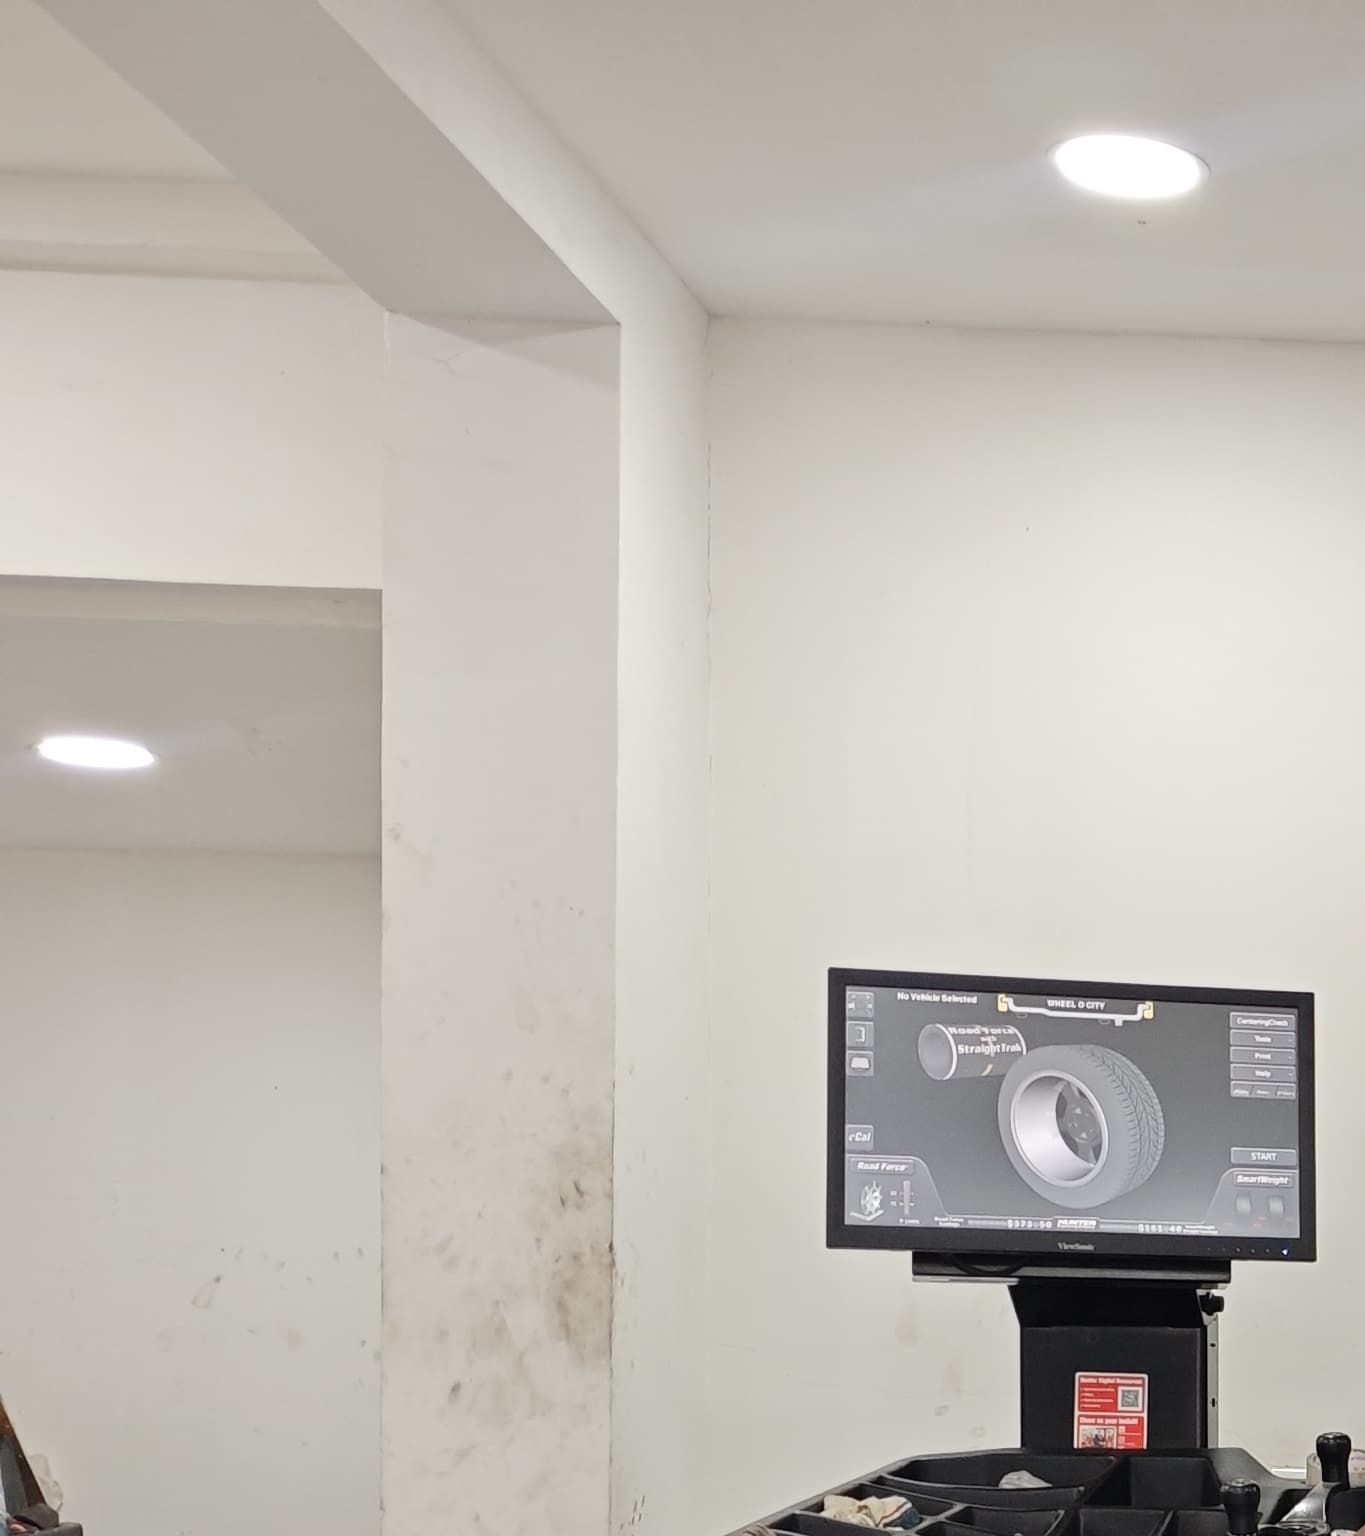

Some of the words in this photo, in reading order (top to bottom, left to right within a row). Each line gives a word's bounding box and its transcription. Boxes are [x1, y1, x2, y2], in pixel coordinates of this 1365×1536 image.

[897, 992, 909, 1000] No
[910, 993, 940, 1002] Vehicle
[942, 994, 977, 1004] Selected
[1047, 999, 1076, 1008] WHEEL
[1086, 1001, 1105, 1010] CITY
[1251, 1152, 1277, 1161] START
[857, 1162, 879, 1170] Road
[1237, 1175, 1289, 1185] SmartWeight
